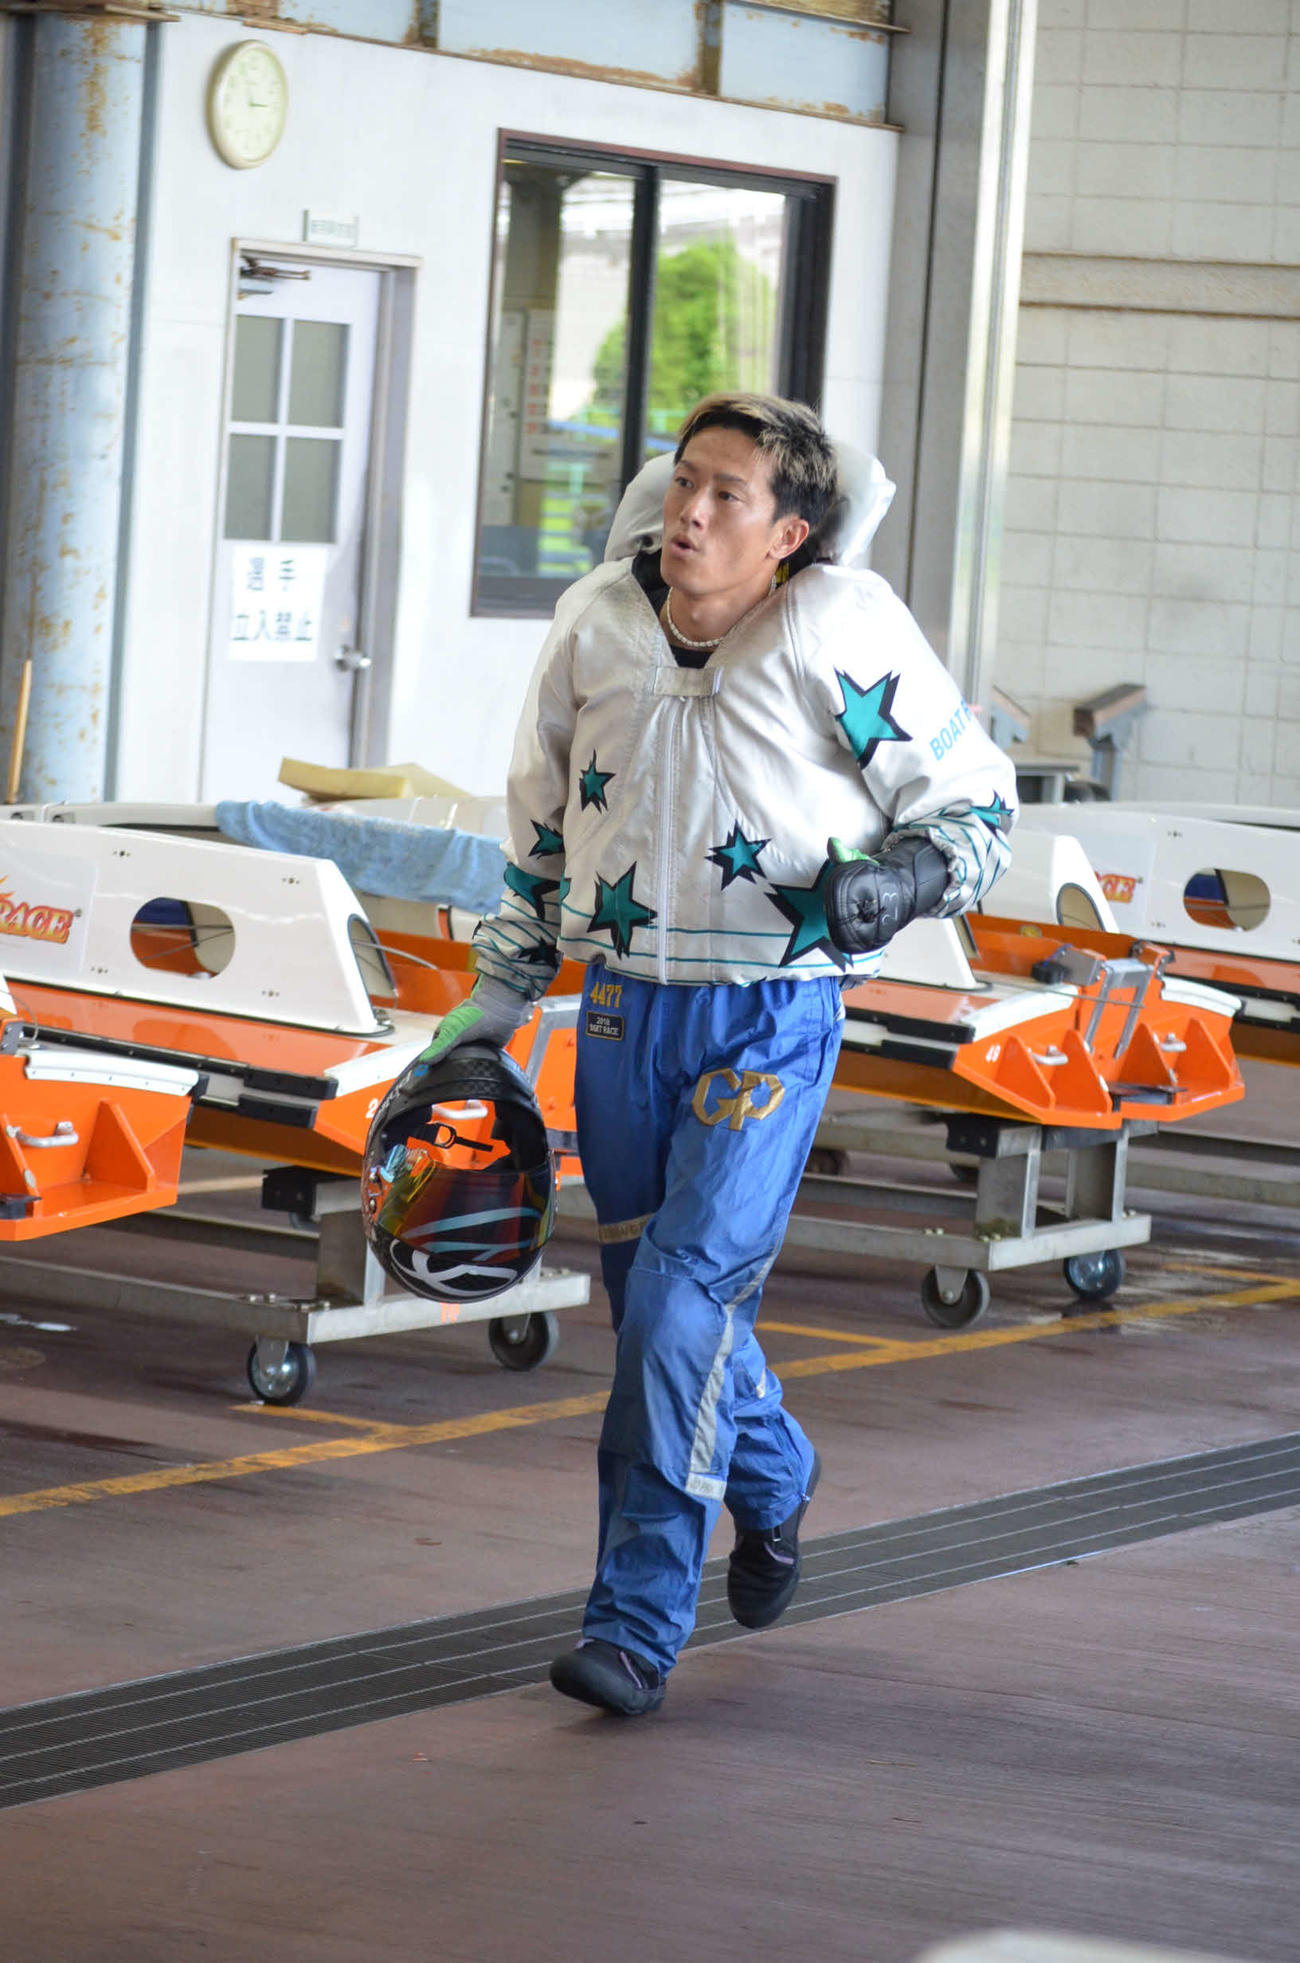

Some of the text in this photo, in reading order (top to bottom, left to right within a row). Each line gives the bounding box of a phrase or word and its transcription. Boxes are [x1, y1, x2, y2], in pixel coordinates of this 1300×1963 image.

[232, 609, 312, 641] 立入禁止
[929, 707, 966, 761] BOAT
[590, 981, 622, 1009] 4477
[692, 1067, 785, 1131] GP
